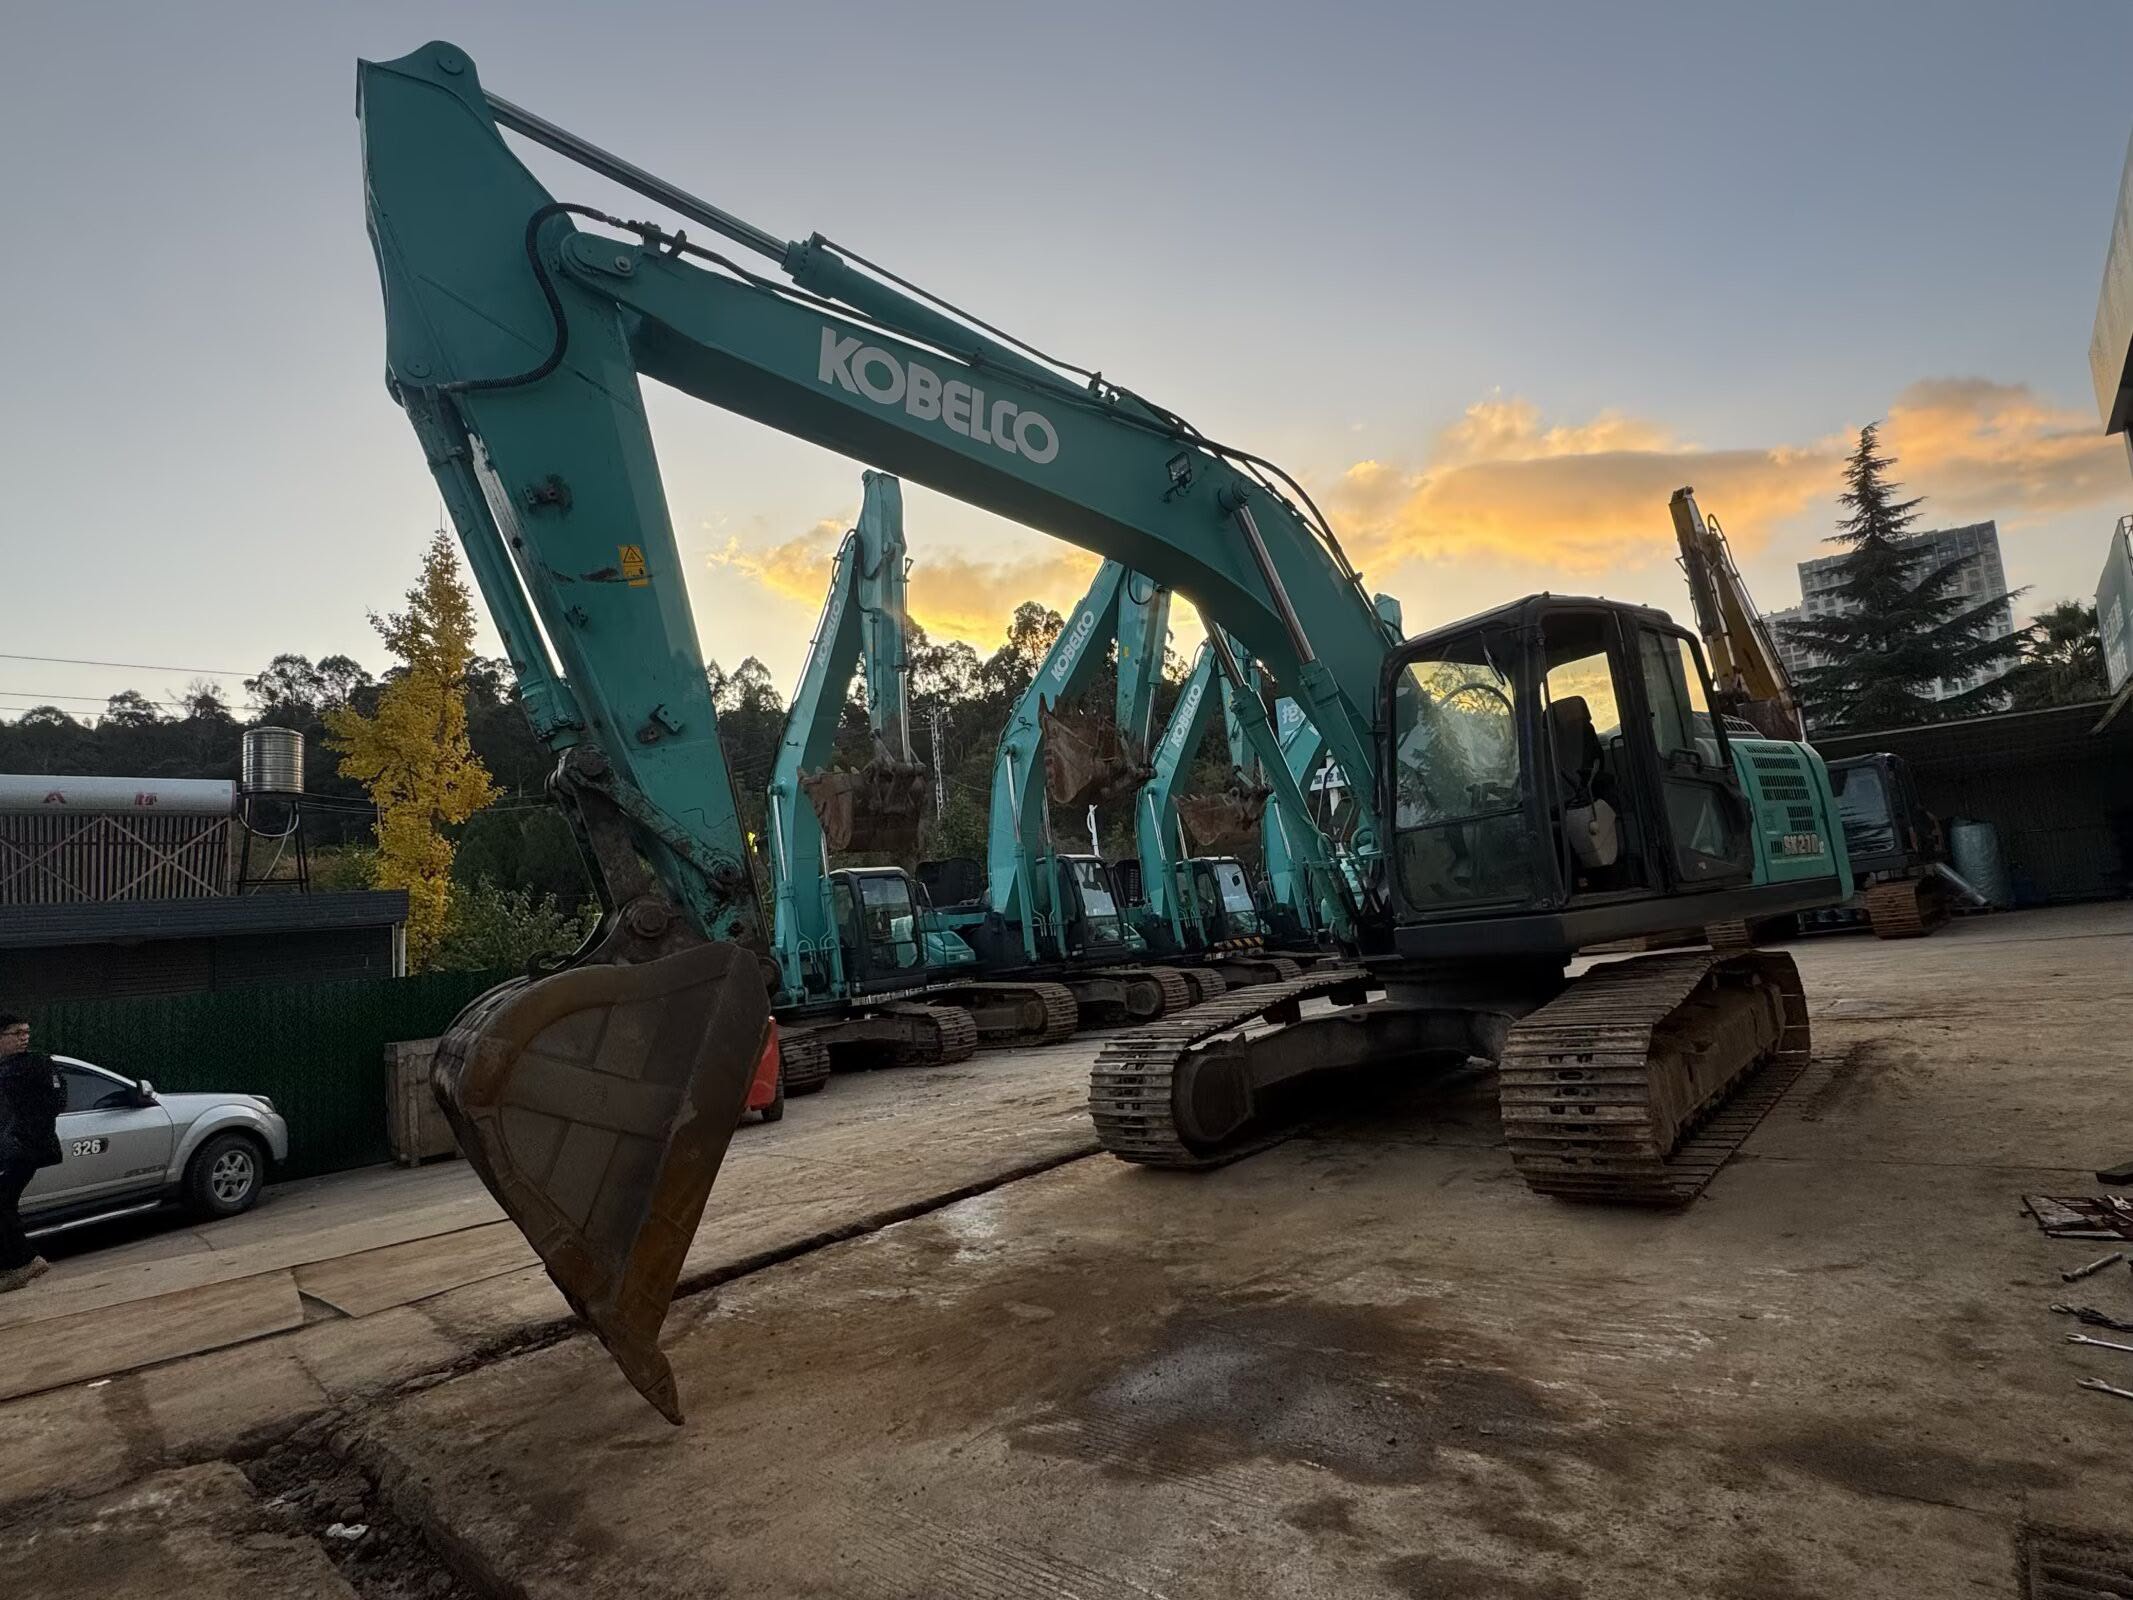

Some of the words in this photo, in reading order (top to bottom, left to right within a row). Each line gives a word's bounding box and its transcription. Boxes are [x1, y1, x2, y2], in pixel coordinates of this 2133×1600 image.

[818, 326, 1059, 464] KOBELCO
[816, 600, 840, 668] KOBELCO
[1051, 611, 1094, 682] KOBELCO
[1171, 684, 1201, 748] KOBELCO
[72, 1139, 101, 1156] 326
